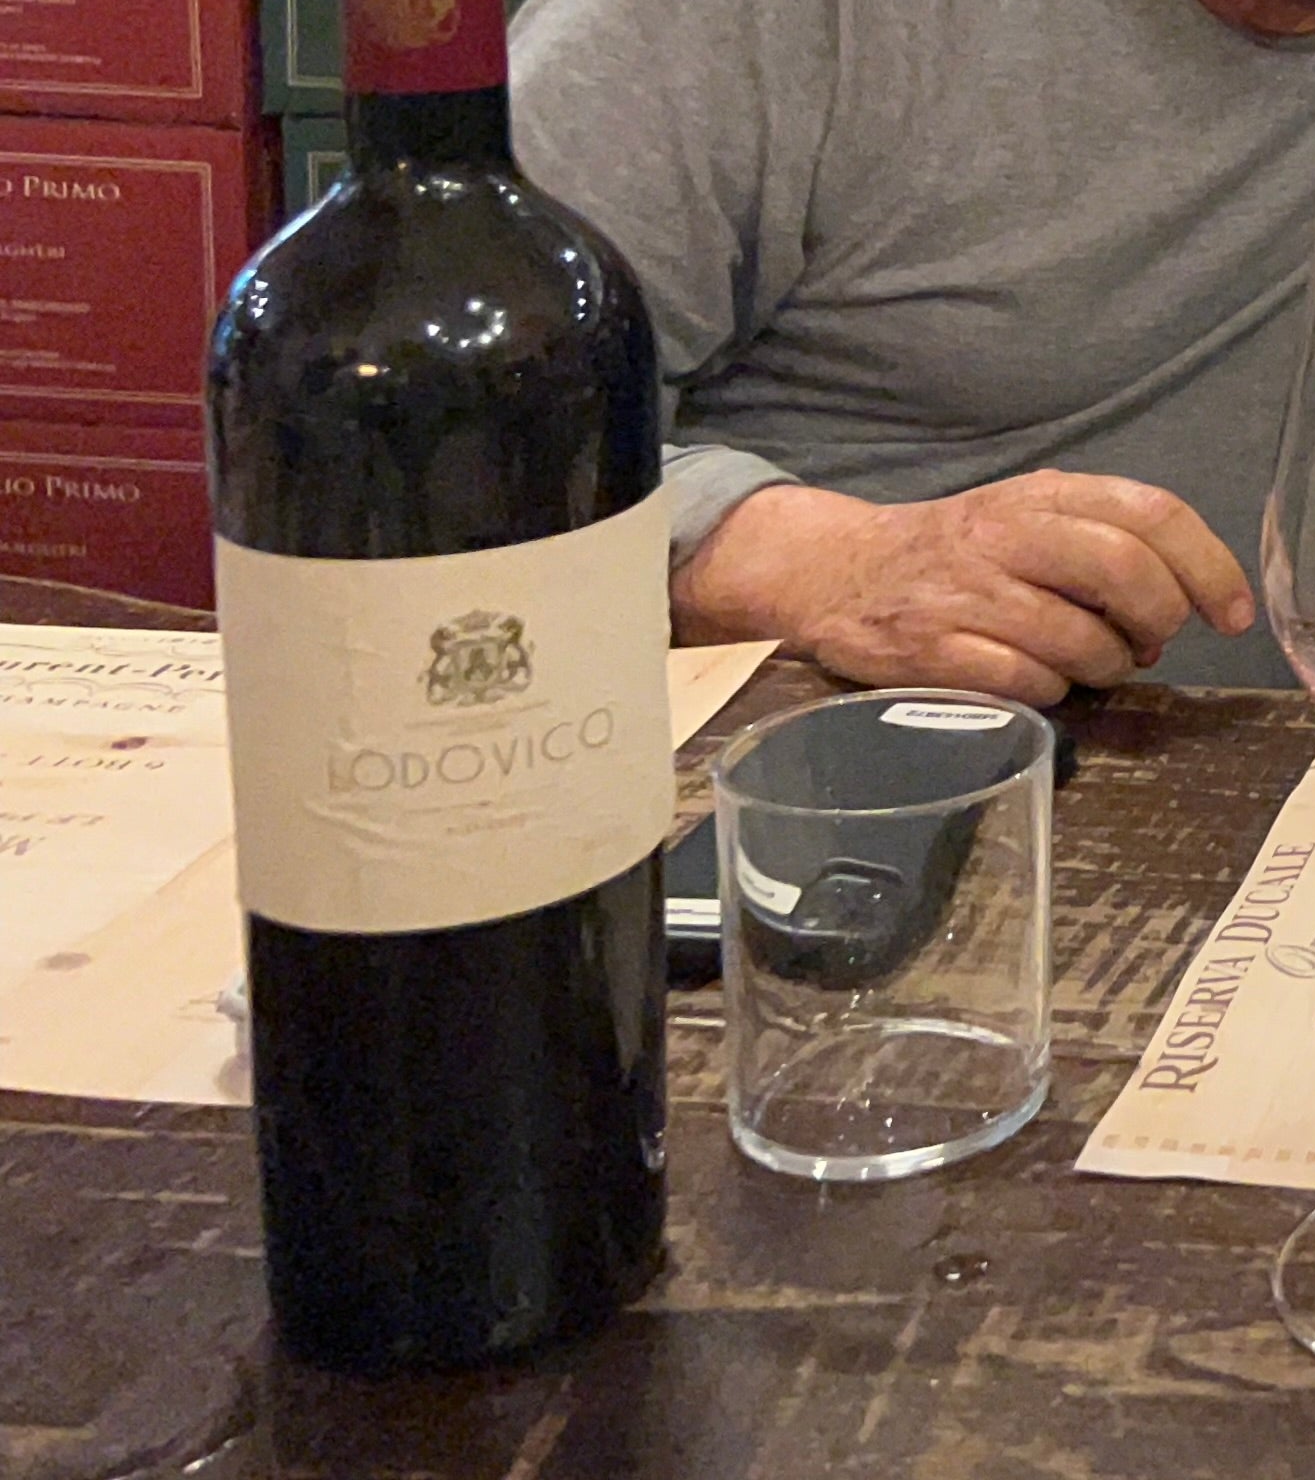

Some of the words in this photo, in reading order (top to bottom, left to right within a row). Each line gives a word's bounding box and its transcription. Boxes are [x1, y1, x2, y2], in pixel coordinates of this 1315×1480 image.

[23, 175, 121, 200] PRIMO
[46, 475, 141, 502] PRIMO
[327, 707, 614, 793] LODOVICO
[1138, 954, 1257, 1094] RISERVA
